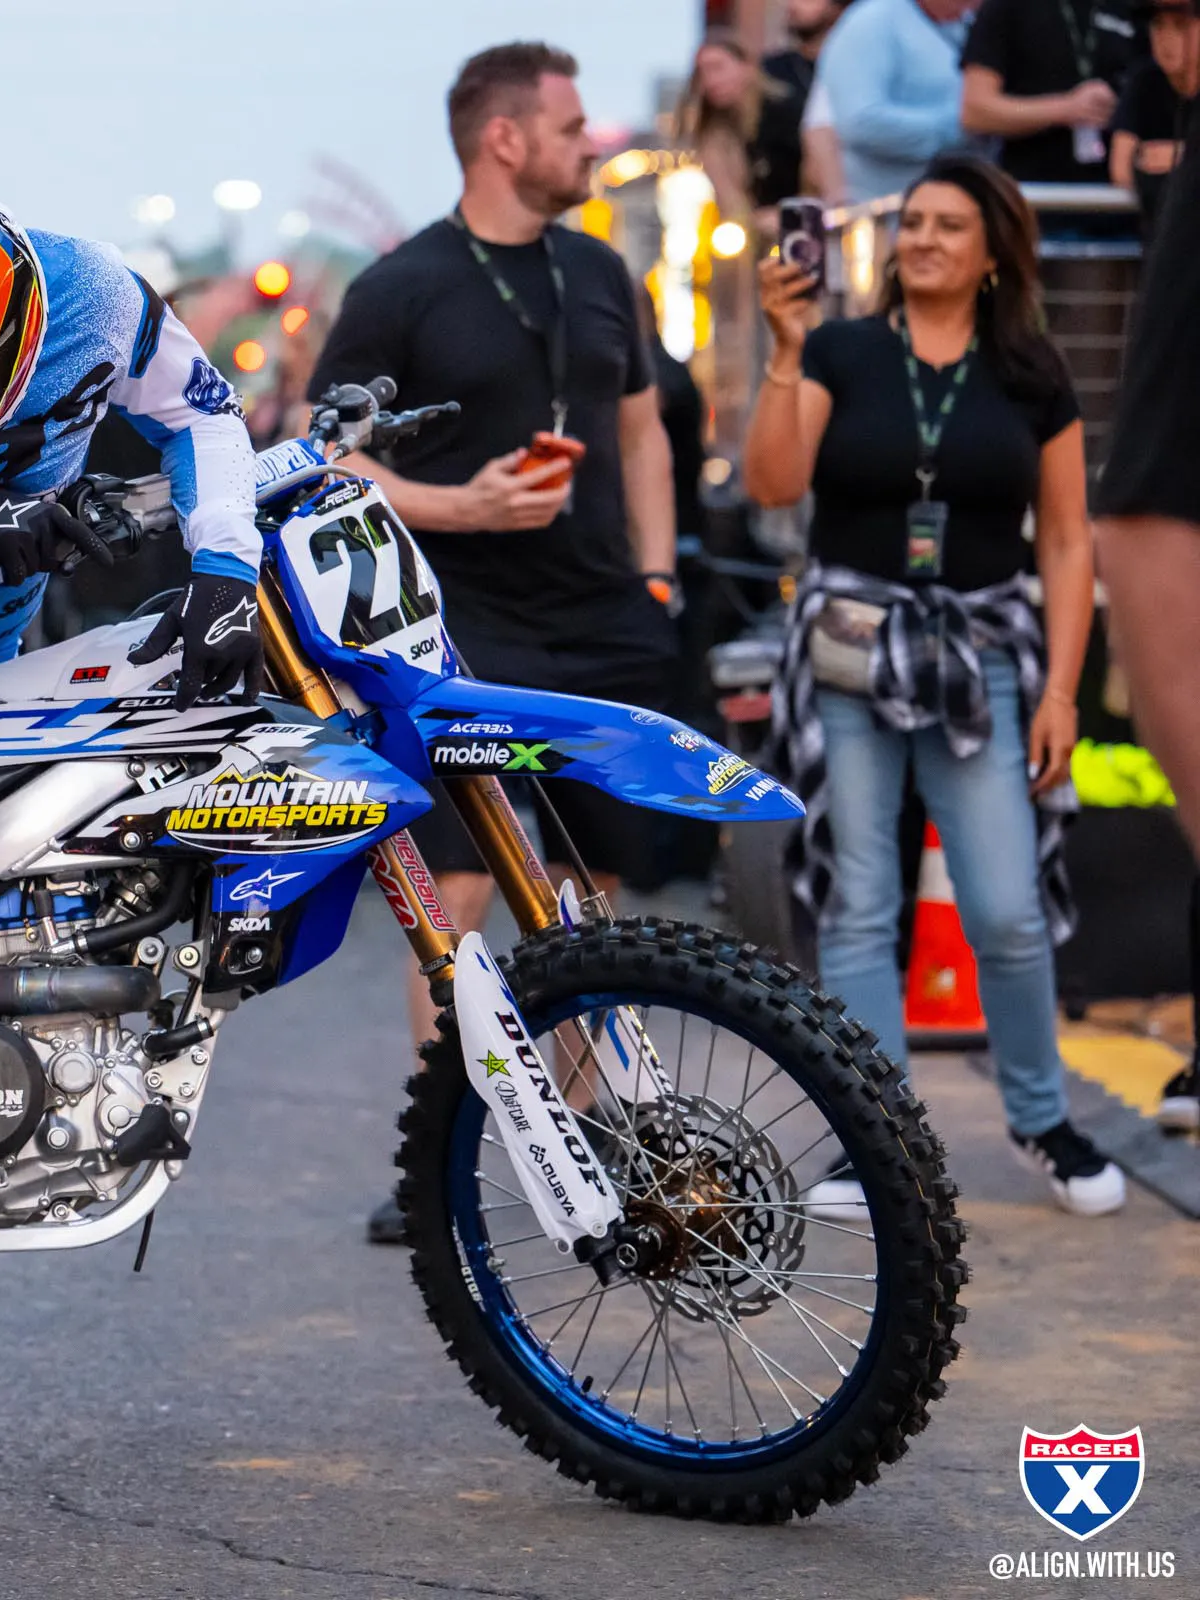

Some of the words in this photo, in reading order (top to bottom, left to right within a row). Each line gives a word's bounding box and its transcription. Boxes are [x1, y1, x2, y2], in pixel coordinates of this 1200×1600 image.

[324, 484, 359, 509] REED
[309, 502, 438, 648] 22
[410, 636, 439, 661] SKDA
[118, 698, 171, 708] BLU
[434, 742, 552, 771] mobileX
[186, 780, 368, 808] MOUNTAIN
[167, 803, 388, 831] MOTORSPORTS
[228, 917, 271, 932] SKDA
[495, 1011, 607, 1197] DUNLOP
[541, 1163, 575, 1218] DUBYA
